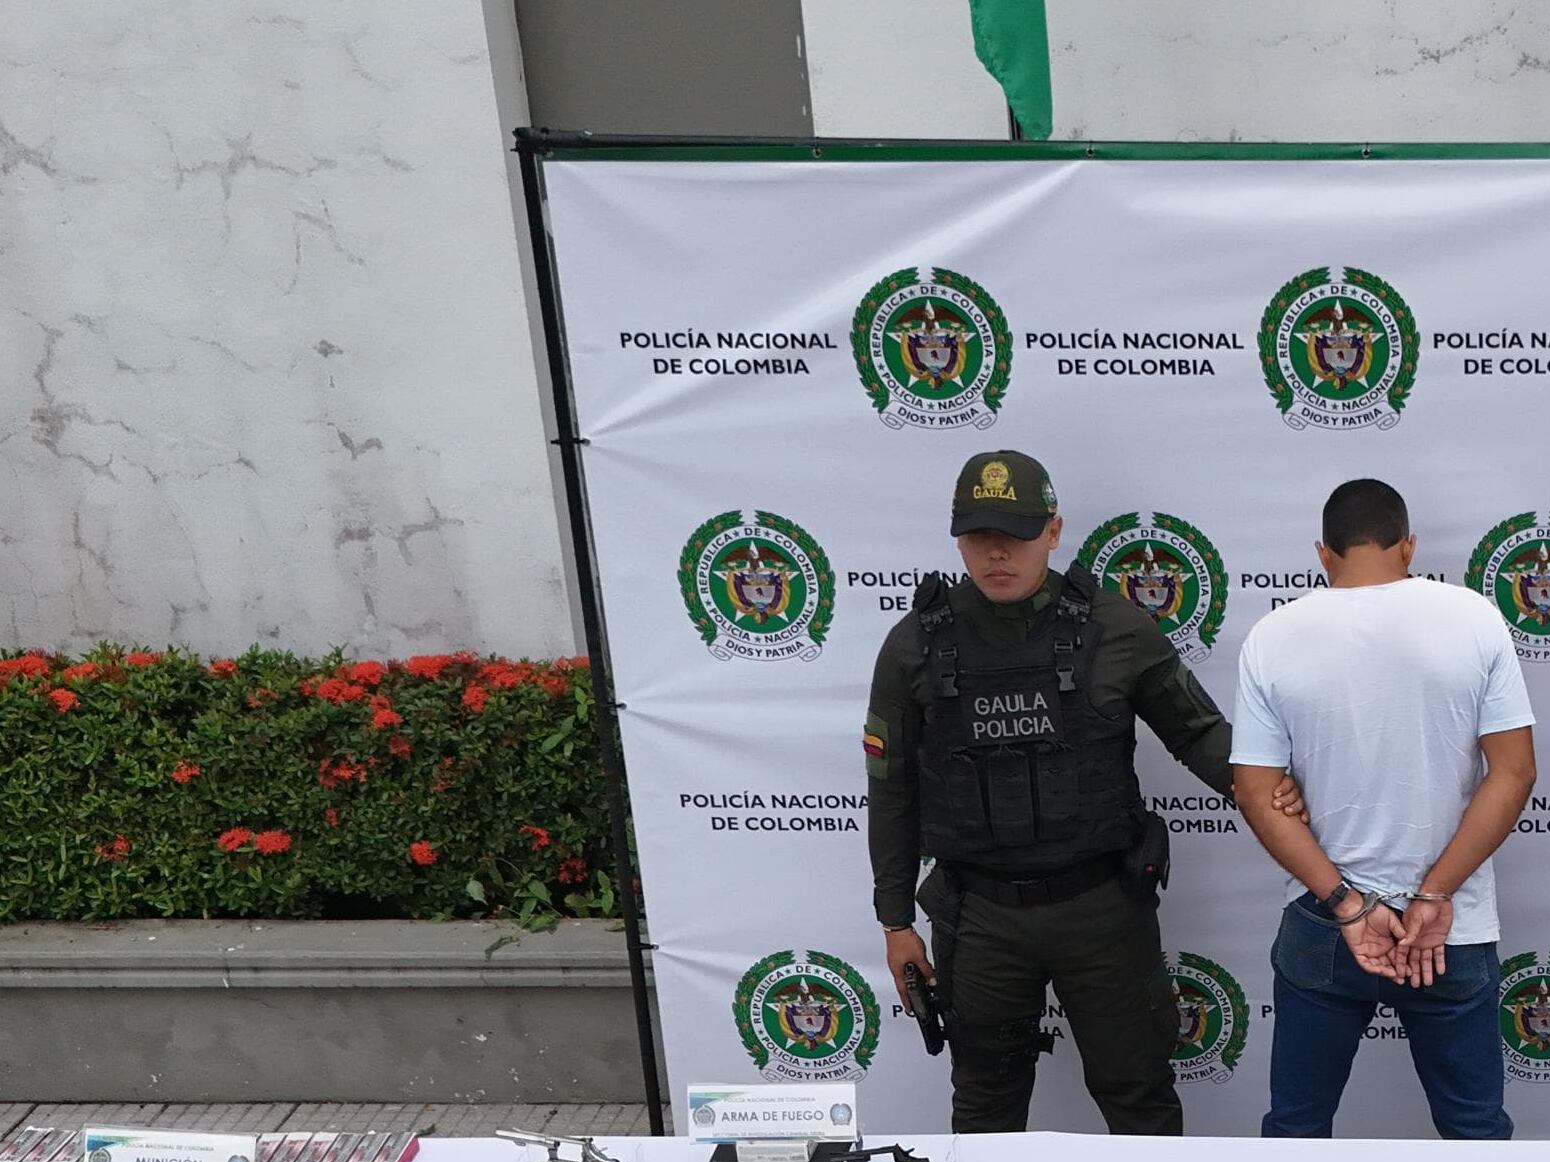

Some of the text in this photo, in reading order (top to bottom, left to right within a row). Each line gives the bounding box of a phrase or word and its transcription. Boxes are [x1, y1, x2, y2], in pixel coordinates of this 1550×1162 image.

[919, 285, 938, 296] DE
[951, 292, 994, 358] COLOMBIA
[1329, 285, 1348, 296] DE
[1360, 292, 1401, 359] COLOMBIA
[620, 328, 838, 350] POLICÍA NACIONAL
[1025, 328, 1245, 350] POLICÍA NACIONAL
[1433, 328, 1524, 349] POLICÍA
[653, 358, 810, 375] DE COLOMBIA
[1057, 359, 1215, 376] DE COLOMBIA
[1464, 358, 1493, 375] DE
[938, 371, 990, 411] NACIONAL
[1341, 372, 1396, 411] NACIONAL
[938, 407, 980, 426] PATRIA
[1341, 407, 1383, 427] PATRIA
[973, 484, 1017, 501] GAULA
[743, 527, 761, 537] DE
[774, 533, 817, 595] COLOMBIA
[1139, 529, 1210, 597] DE COLOMBIA
[1241, 569, 1328, 589] POLICÍA
[879, 596, 908, 611] DE
[764, 607, 814, 644] NACIONAL
[765, 640, 805, 658] PATRIA
[974, 692, 1048, 716] GAULA
[972, 716, 1055, 740] POLICIA
[679, 791, 869, 809] POLICÍA NACIONA
[1152, 796, 1239, 811] NACION
[711, 816, 860, 832] DE COLOMBIA
[1168, 819, 1239, 833] OMBIA
[795, 965, 811, 974] DE
[823, 970, 863, 1025] COLOMBIA
[1167, 966, 1184, 975] DE
[1195, 972, 1232, 1026] COLOMBIA
[813, 1036, 860, 1068] NACIONAL
[1180, 1036, 1228, 1069] NACIONAL
[721, 1110, 825, 1122] ARMA DE FUEGO
